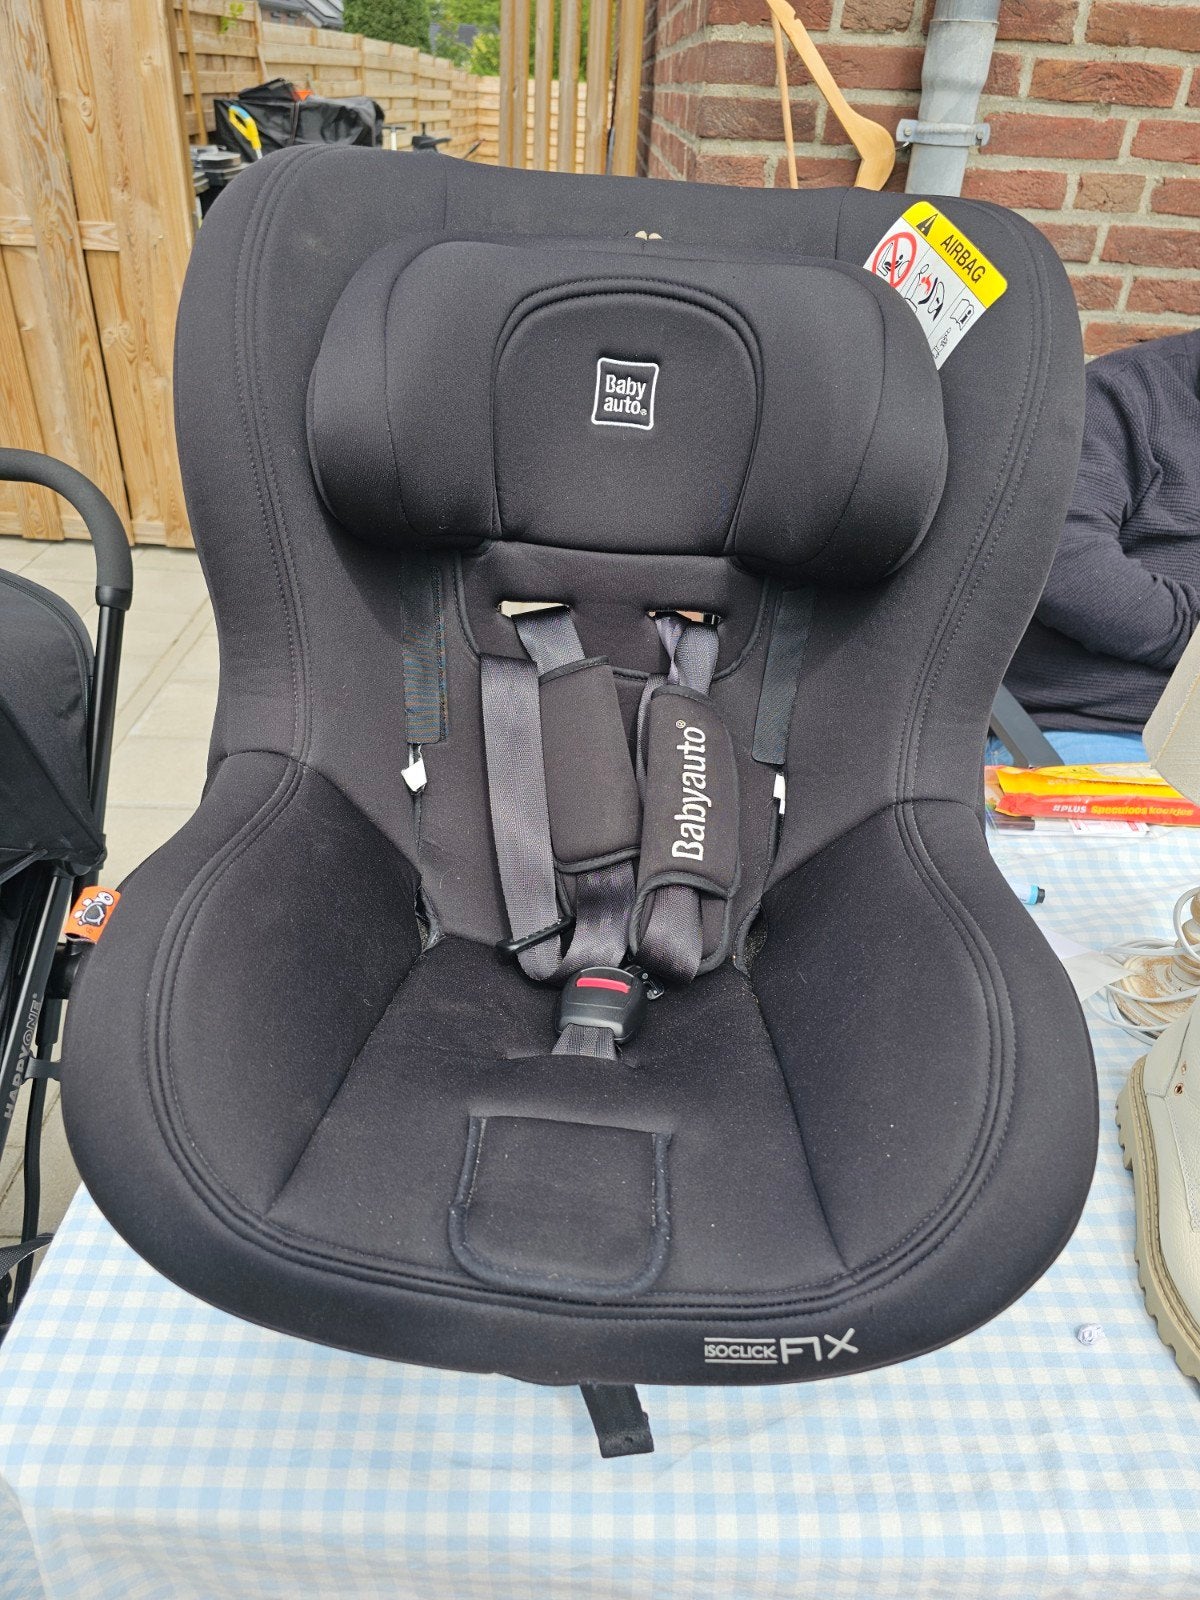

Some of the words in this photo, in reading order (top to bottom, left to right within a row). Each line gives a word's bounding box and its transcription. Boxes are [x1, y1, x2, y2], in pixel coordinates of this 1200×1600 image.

[939, 234, 986, 284] AIRBAG
[605, 374, 647, 400] Baby
[1060, 804, 1087, 814] PLUS
[704, 1344, 778, 1359] ISOCLICK
